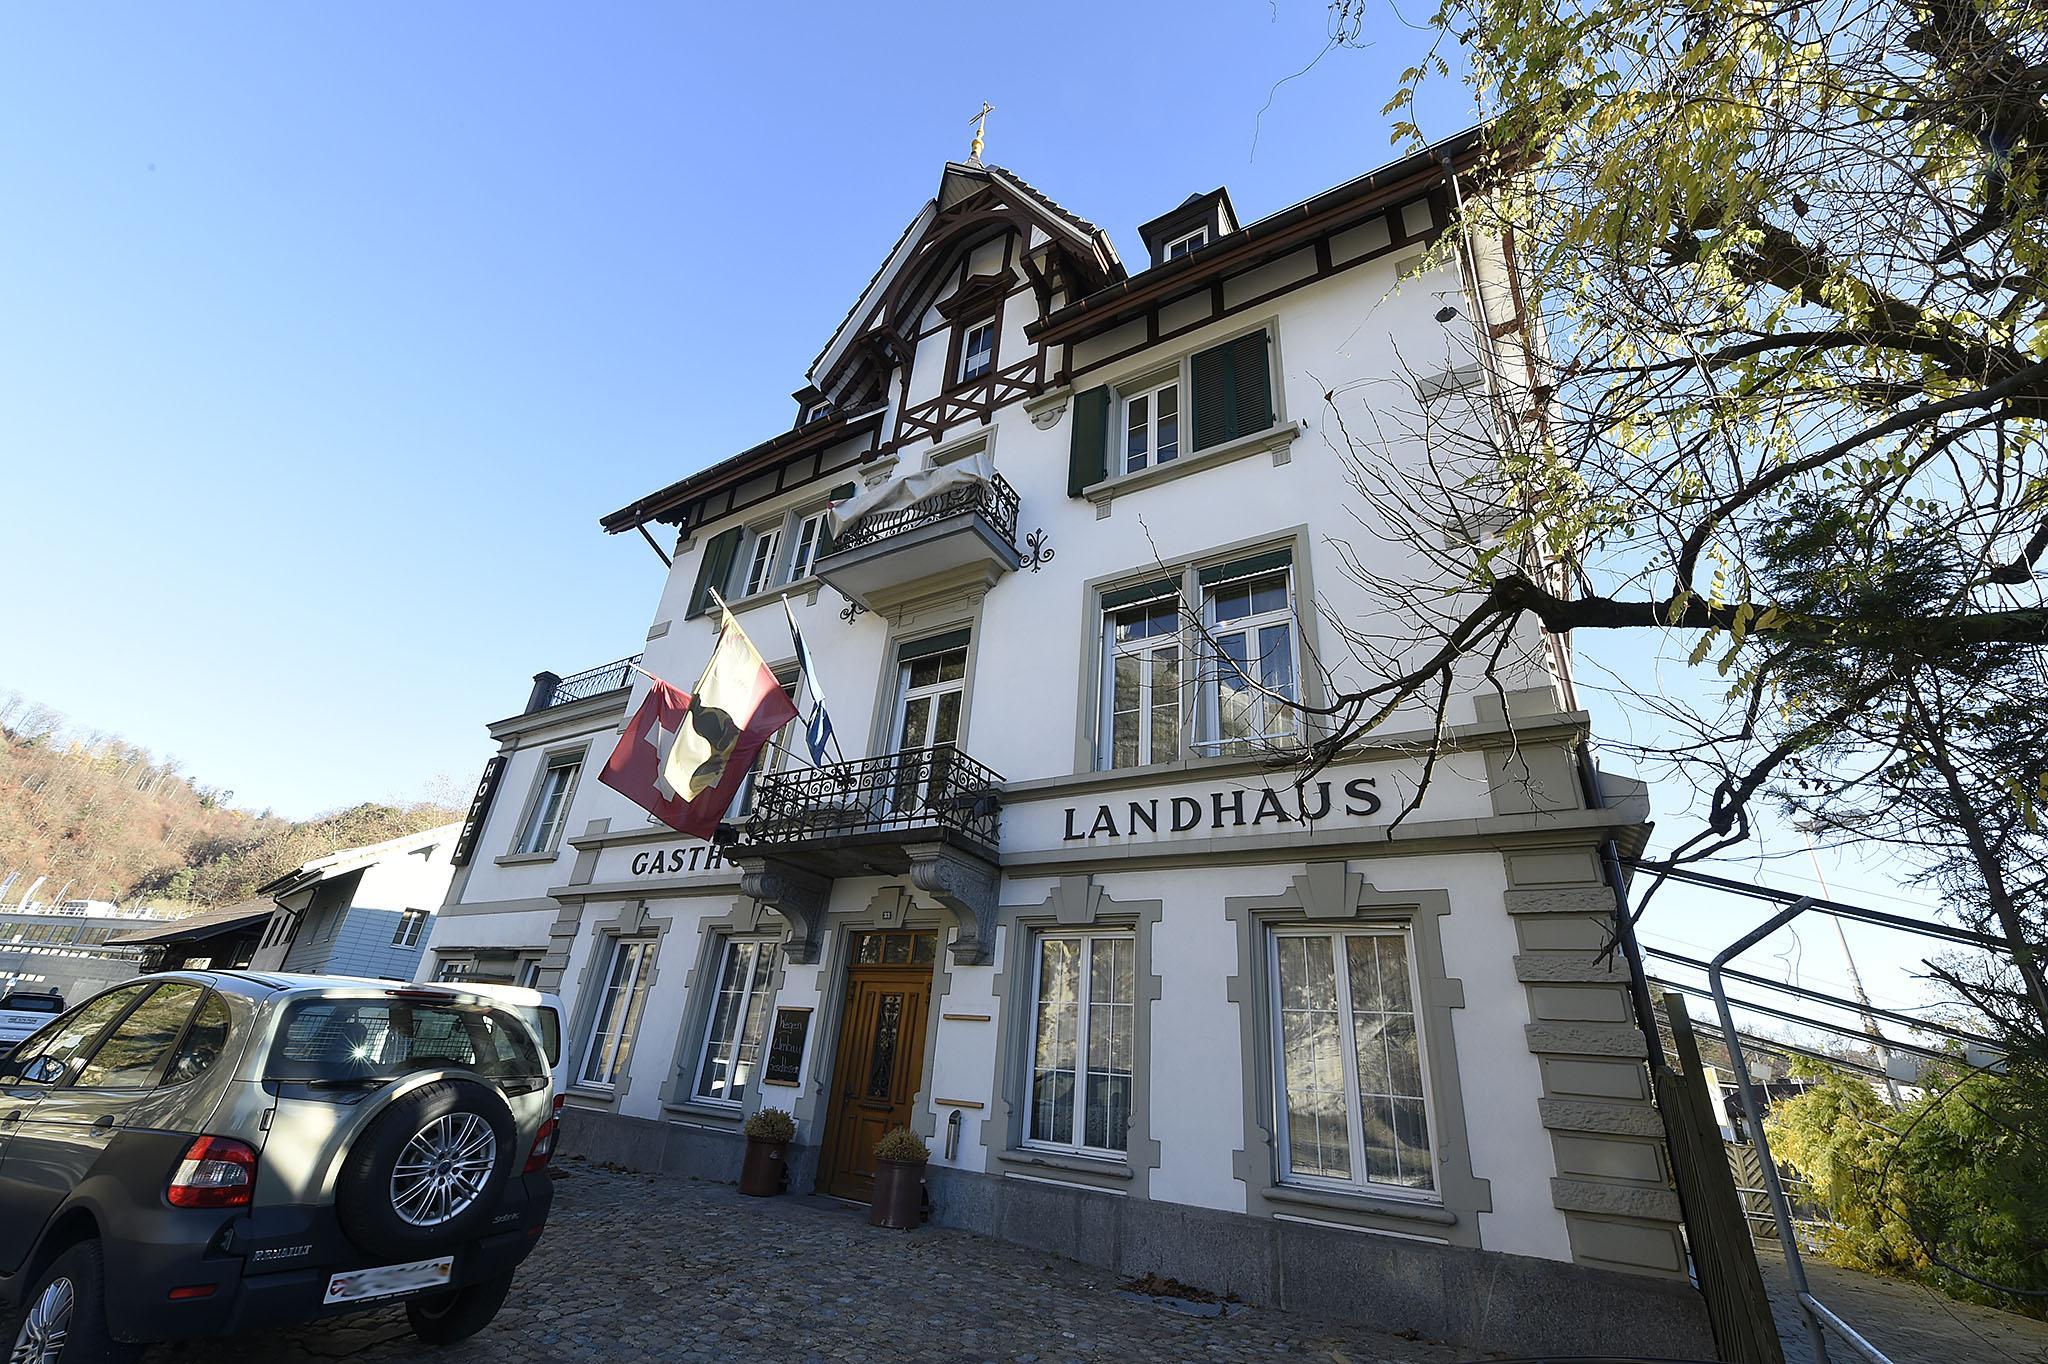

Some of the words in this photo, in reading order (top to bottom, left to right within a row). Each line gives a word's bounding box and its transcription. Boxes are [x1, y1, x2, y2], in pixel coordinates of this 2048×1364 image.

[454, 763, 496, 858] HOTEL
[1063, 777, 1382, 841] LANDHAUS
[255, 1244, 312, 1261] RENAULT
